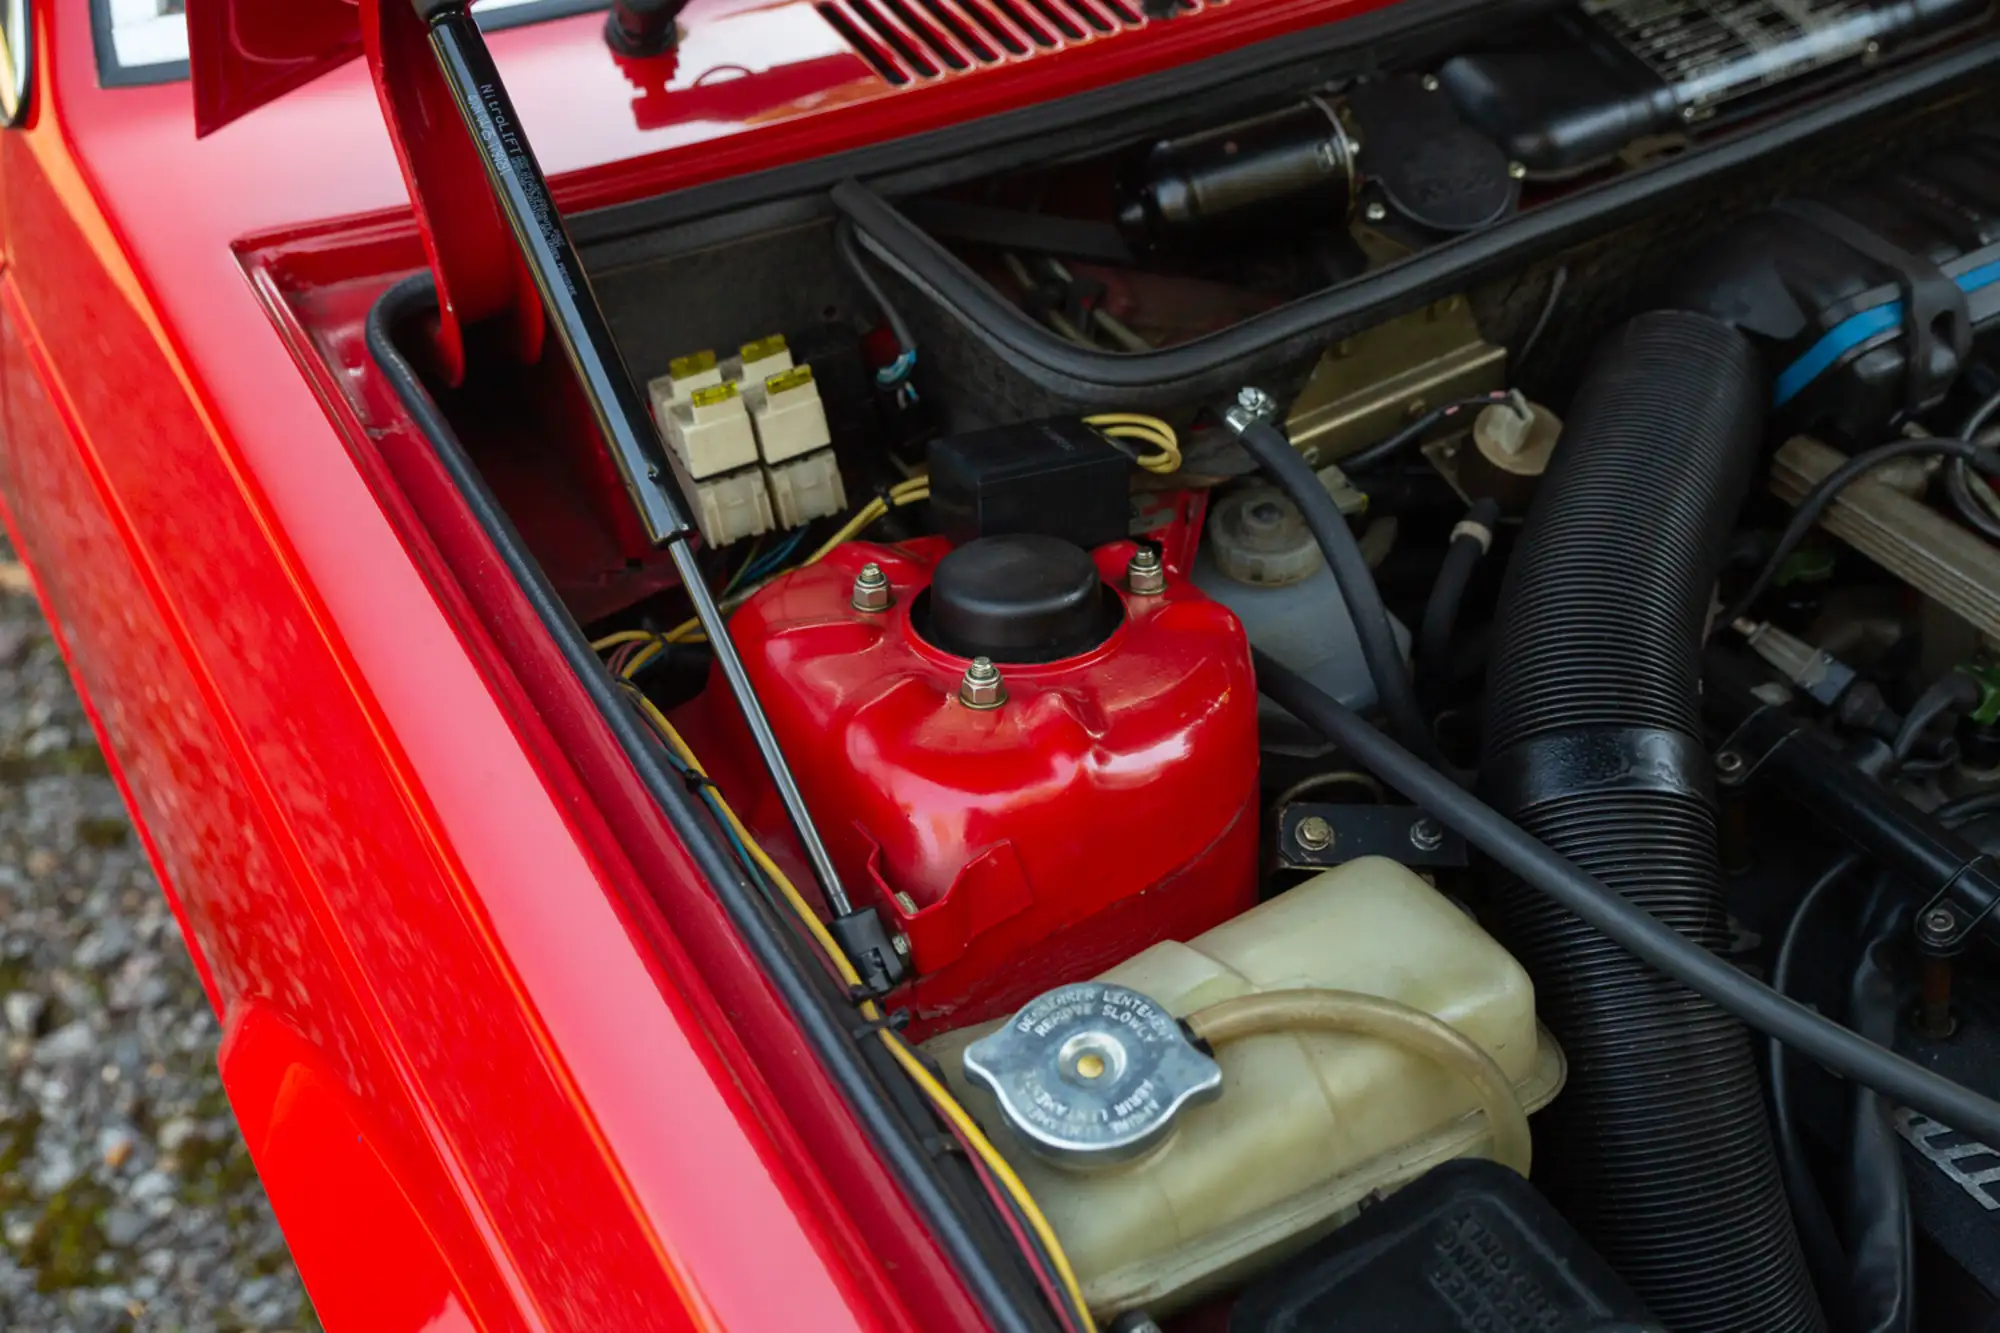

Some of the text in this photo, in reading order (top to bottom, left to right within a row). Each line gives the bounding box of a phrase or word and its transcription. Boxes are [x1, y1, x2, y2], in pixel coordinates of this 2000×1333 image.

[480, 83, 522, 154] NitroLIFT
[1034, 1003, 1155, 1042] REMOVE SLOWLY
[1102, 990, 1174, 1041] LENTEMENT
